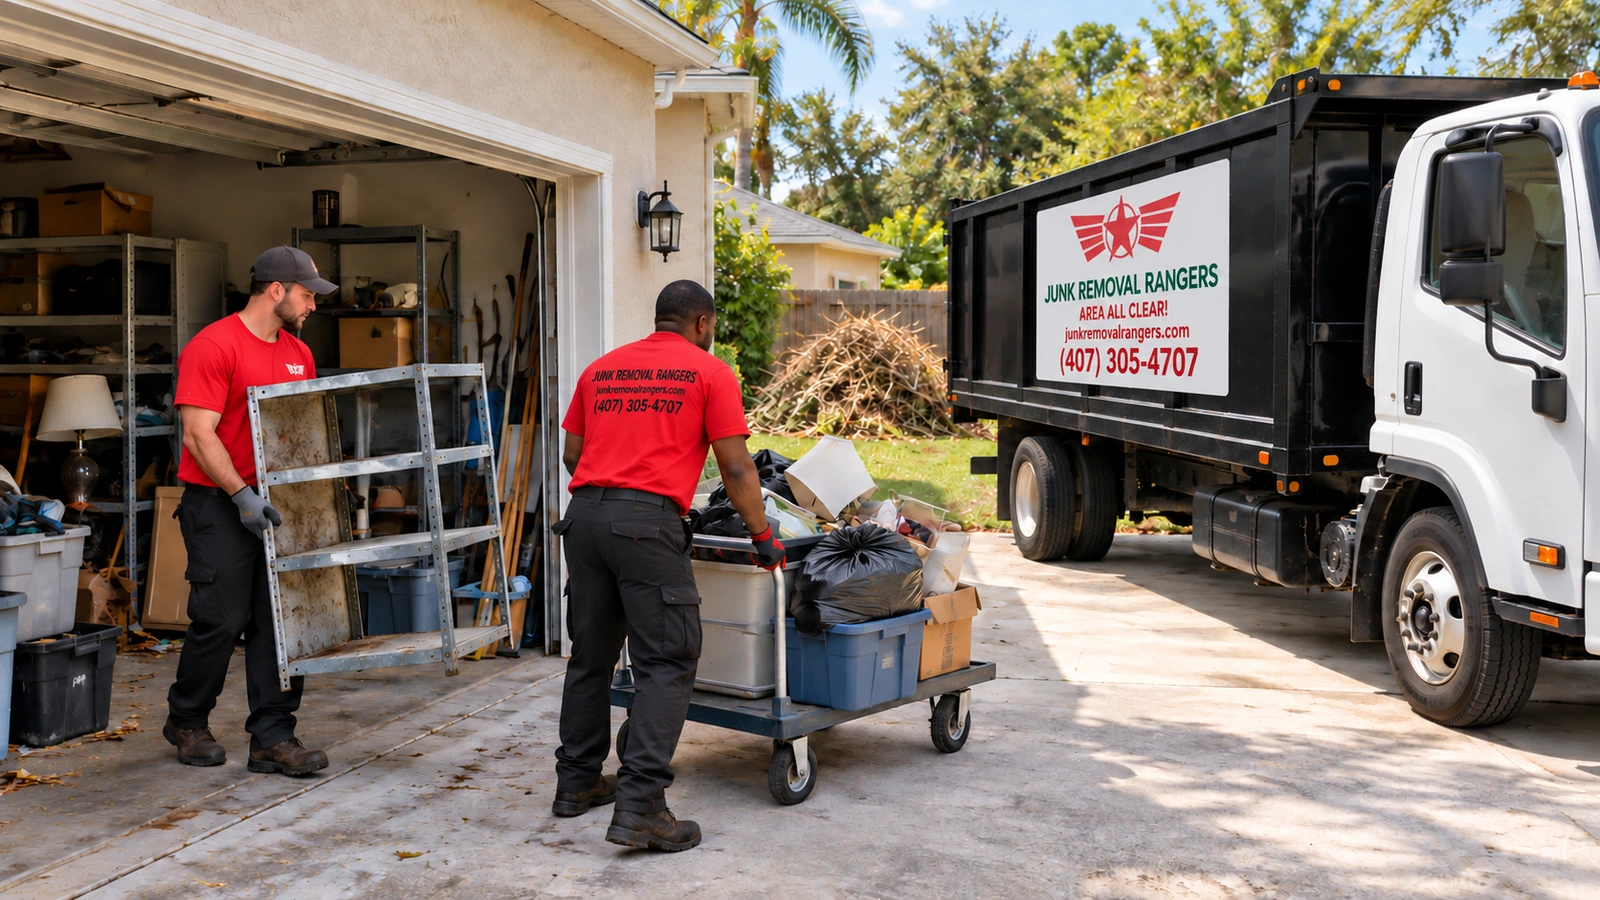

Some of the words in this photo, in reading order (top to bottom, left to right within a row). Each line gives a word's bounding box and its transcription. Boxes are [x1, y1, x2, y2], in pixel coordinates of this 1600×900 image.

[1044, 281, 1075, 303] JUNK
[1078, 274, 1141, 300] REMOVAL
[1144, 263, 1218, 294] RANGERS
[1079, 305, 1104, 321] AREA
[1107, 304, 1126, 320] ALL
[1128, 300, 1168, 318] CLEAR!
[1064, 325, 1190, 343] junkremovalrangers.com
[1060, 347, 1101, 378] (407)
[1106, 347, 1199, 377] 305-4707
[592, 370, 615, 382] JUNK
[615, 369, 654, 381] REMOVAL
[656, 369, 697, 383] RANGERS
[594, 399, 623, 415] (407)
[626, 399, 683, 414] 305-4707
